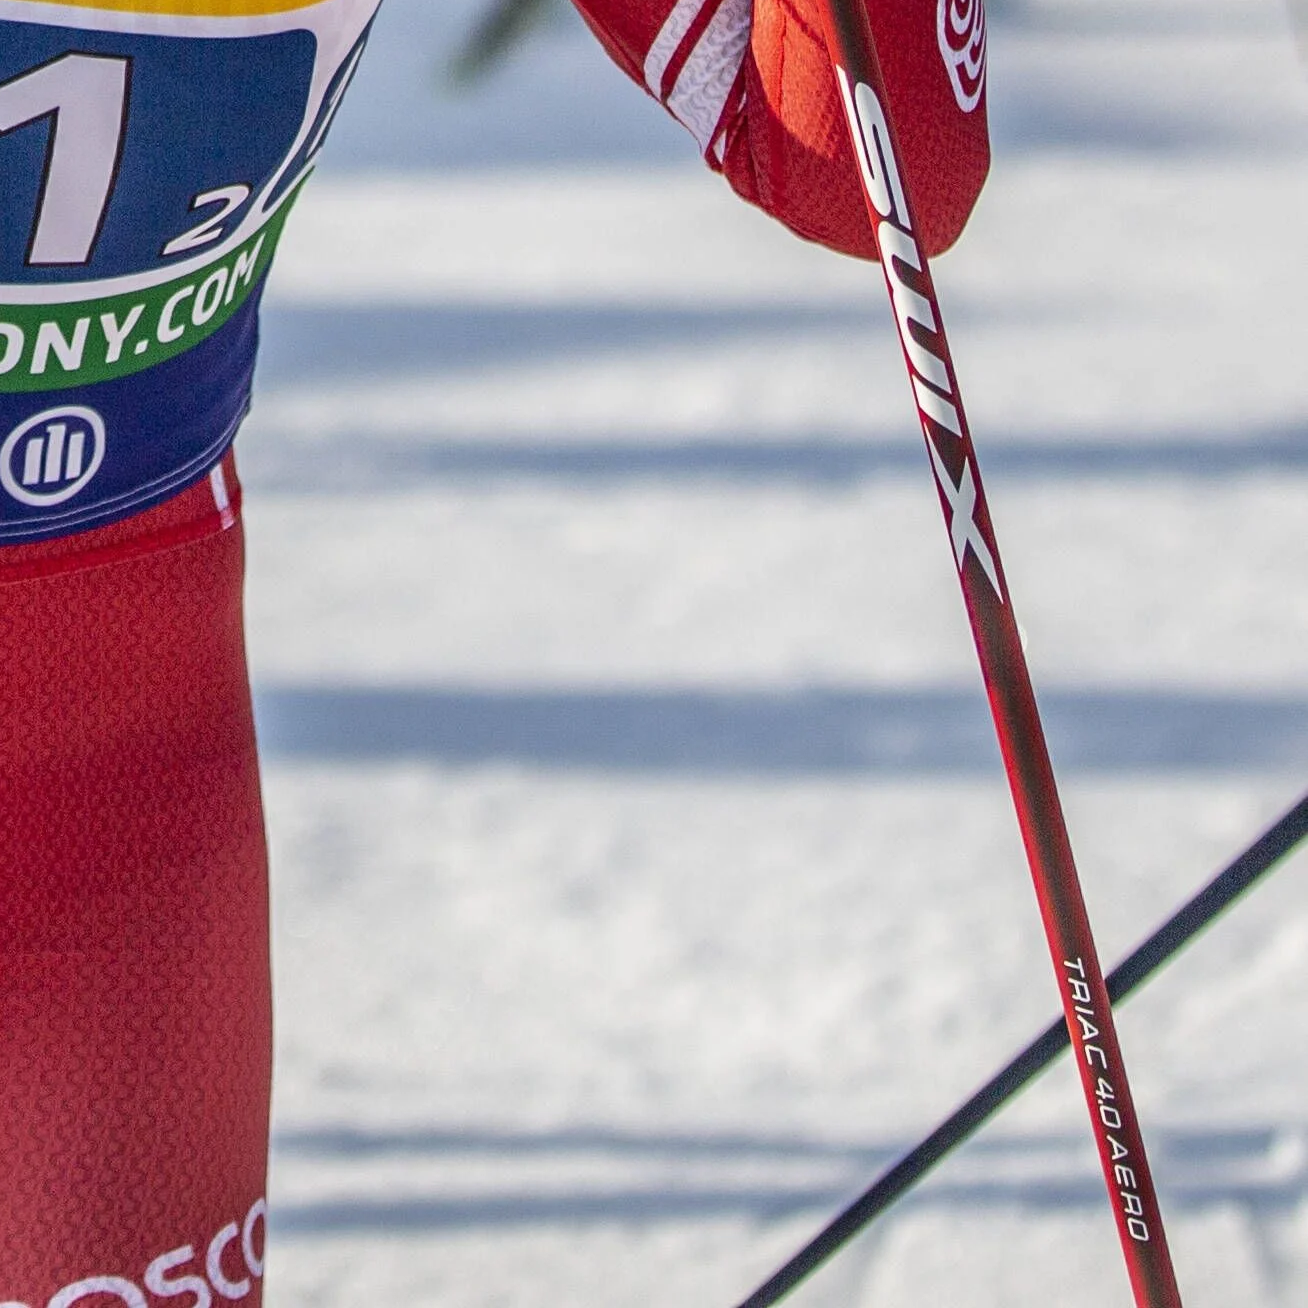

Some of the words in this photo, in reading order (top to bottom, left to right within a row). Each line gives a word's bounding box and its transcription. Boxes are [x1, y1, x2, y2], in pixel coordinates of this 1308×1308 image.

[160, 182, 251, 259] 2
[836, 63, 1004, 606] SWIX
[1063, 957, 1109, 1069] TRIAC
[1107, 1135, 1149, 1243] AERO
